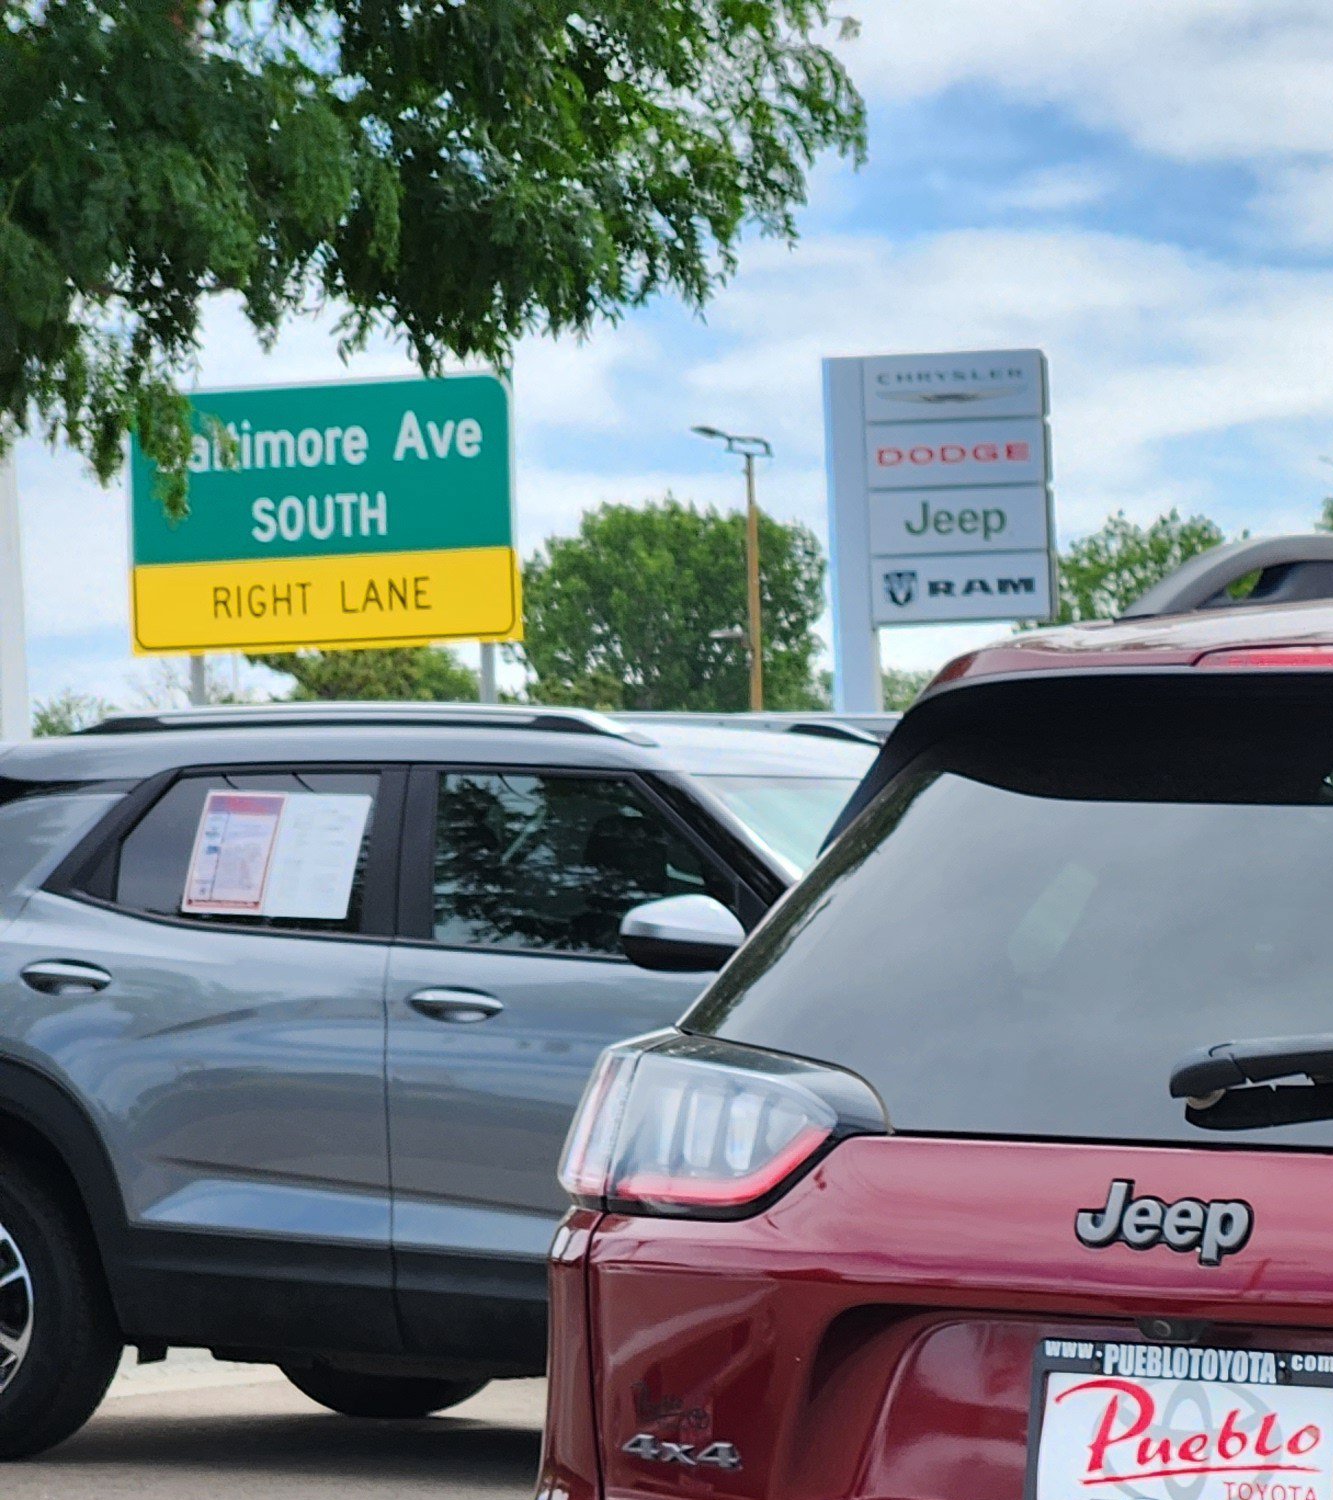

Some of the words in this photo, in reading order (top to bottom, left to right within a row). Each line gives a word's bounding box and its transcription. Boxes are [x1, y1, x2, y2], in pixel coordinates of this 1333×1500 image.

[876, 367, 1024, 386] CHRYSLER
[186, 418, 368, 474] altimore
[394, 410, 483, 461] Ave
[876, 442, 1031, 467] DODGE
[251, 491, 388, 542] SOUTH
[904, 500, 1007, 541] Jeep
[213, 582, 312, 619] RIGHT
[341, 576, 432, 614] LANE
[928, 577, 1036, 598] RAM
[1075, 1178, 1254, 1266] Jeep
[1055, 1379, 1322, 1473] Pueblo
[622, 1433, 742, 1470] 4x4
